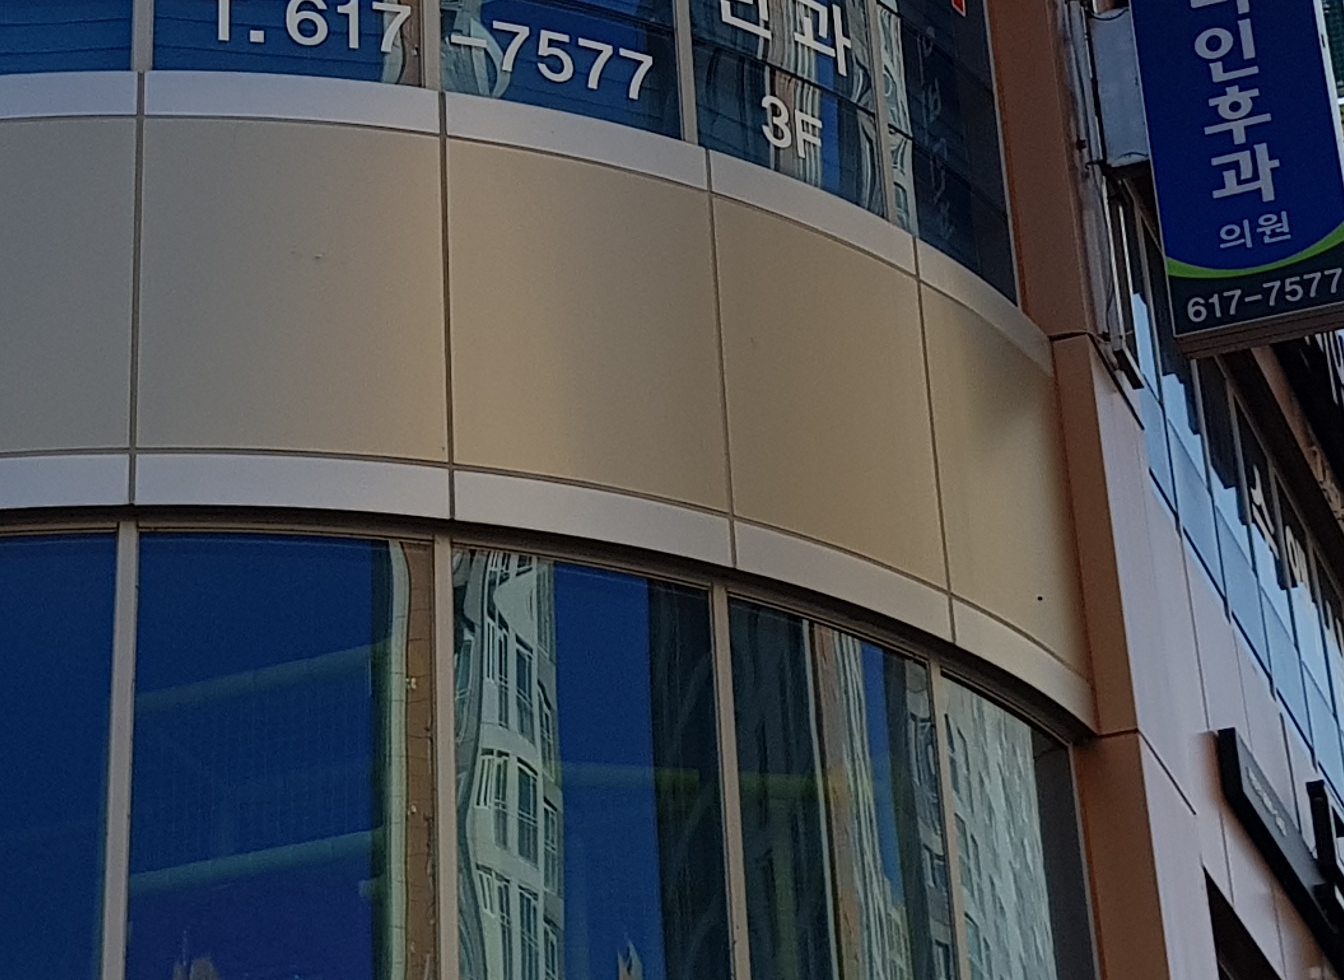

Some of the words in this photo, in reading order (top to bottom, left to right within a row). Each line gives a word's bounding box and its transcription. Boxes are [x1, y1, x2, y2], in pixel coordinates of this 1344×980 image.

[760, 94, 824, 160] 3F
[1218, 210, 1292, 251] 의원
[1186, 268, 1344, 324] 617-7577
